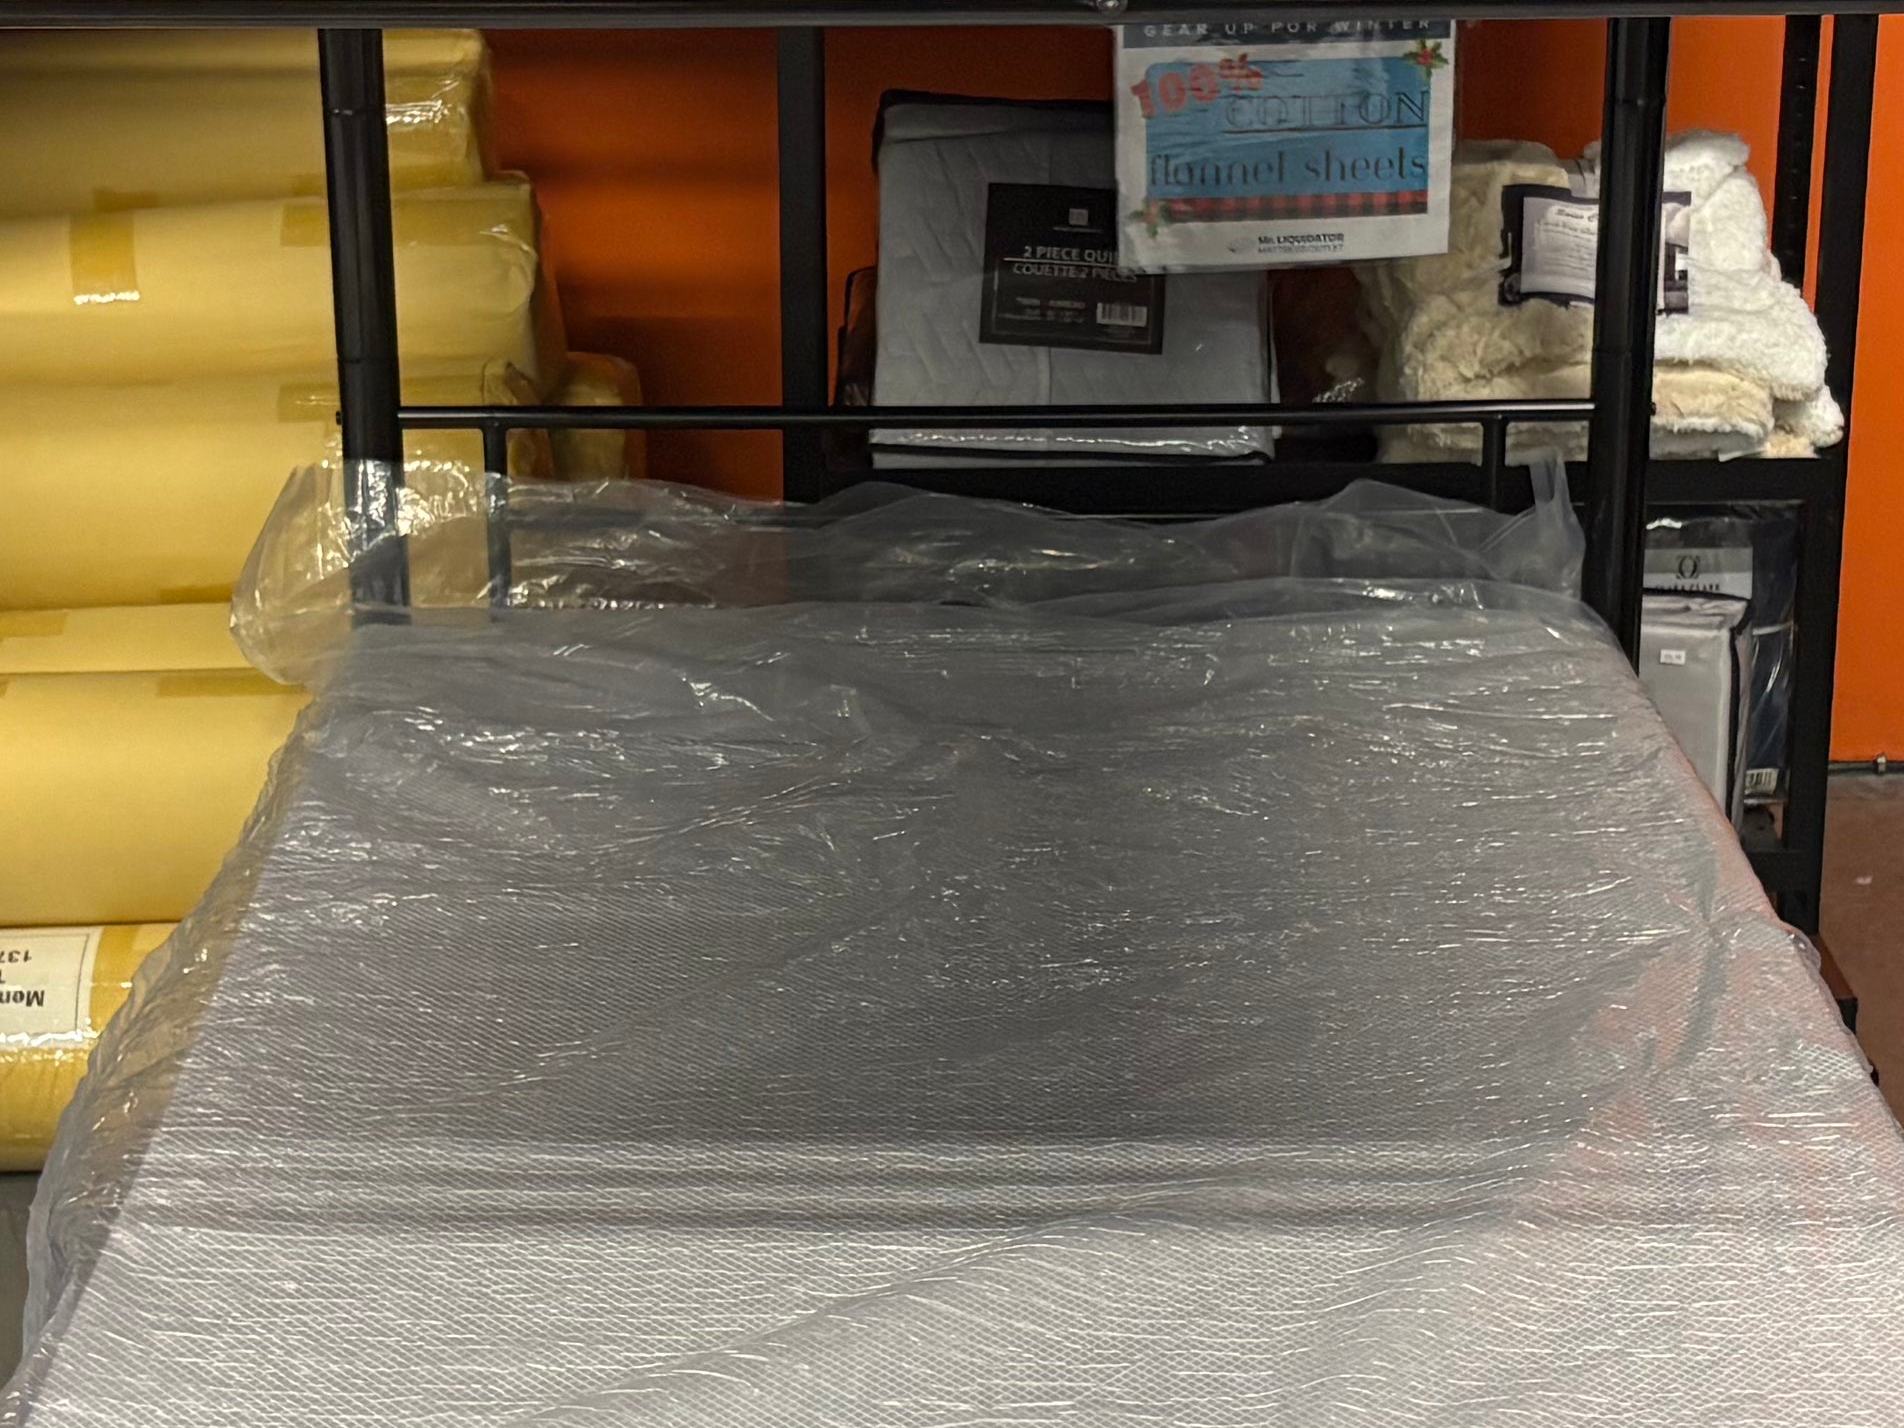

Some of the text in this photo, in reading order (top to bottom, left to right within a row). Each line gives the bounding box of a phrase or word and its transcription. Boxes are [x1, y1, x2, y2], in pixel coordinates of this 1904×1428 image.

[1144, 24, 1209, 38] GEAR
[1226, 22, 1256, 35] UP
[1130, 53, 1264, 119] 100%
[1225, 90, 1431, 128] COTTON
[1151, 146, 1427, 187] flannel sheets
[1024, 246, 1118, 264] 2 PIECE QUI
